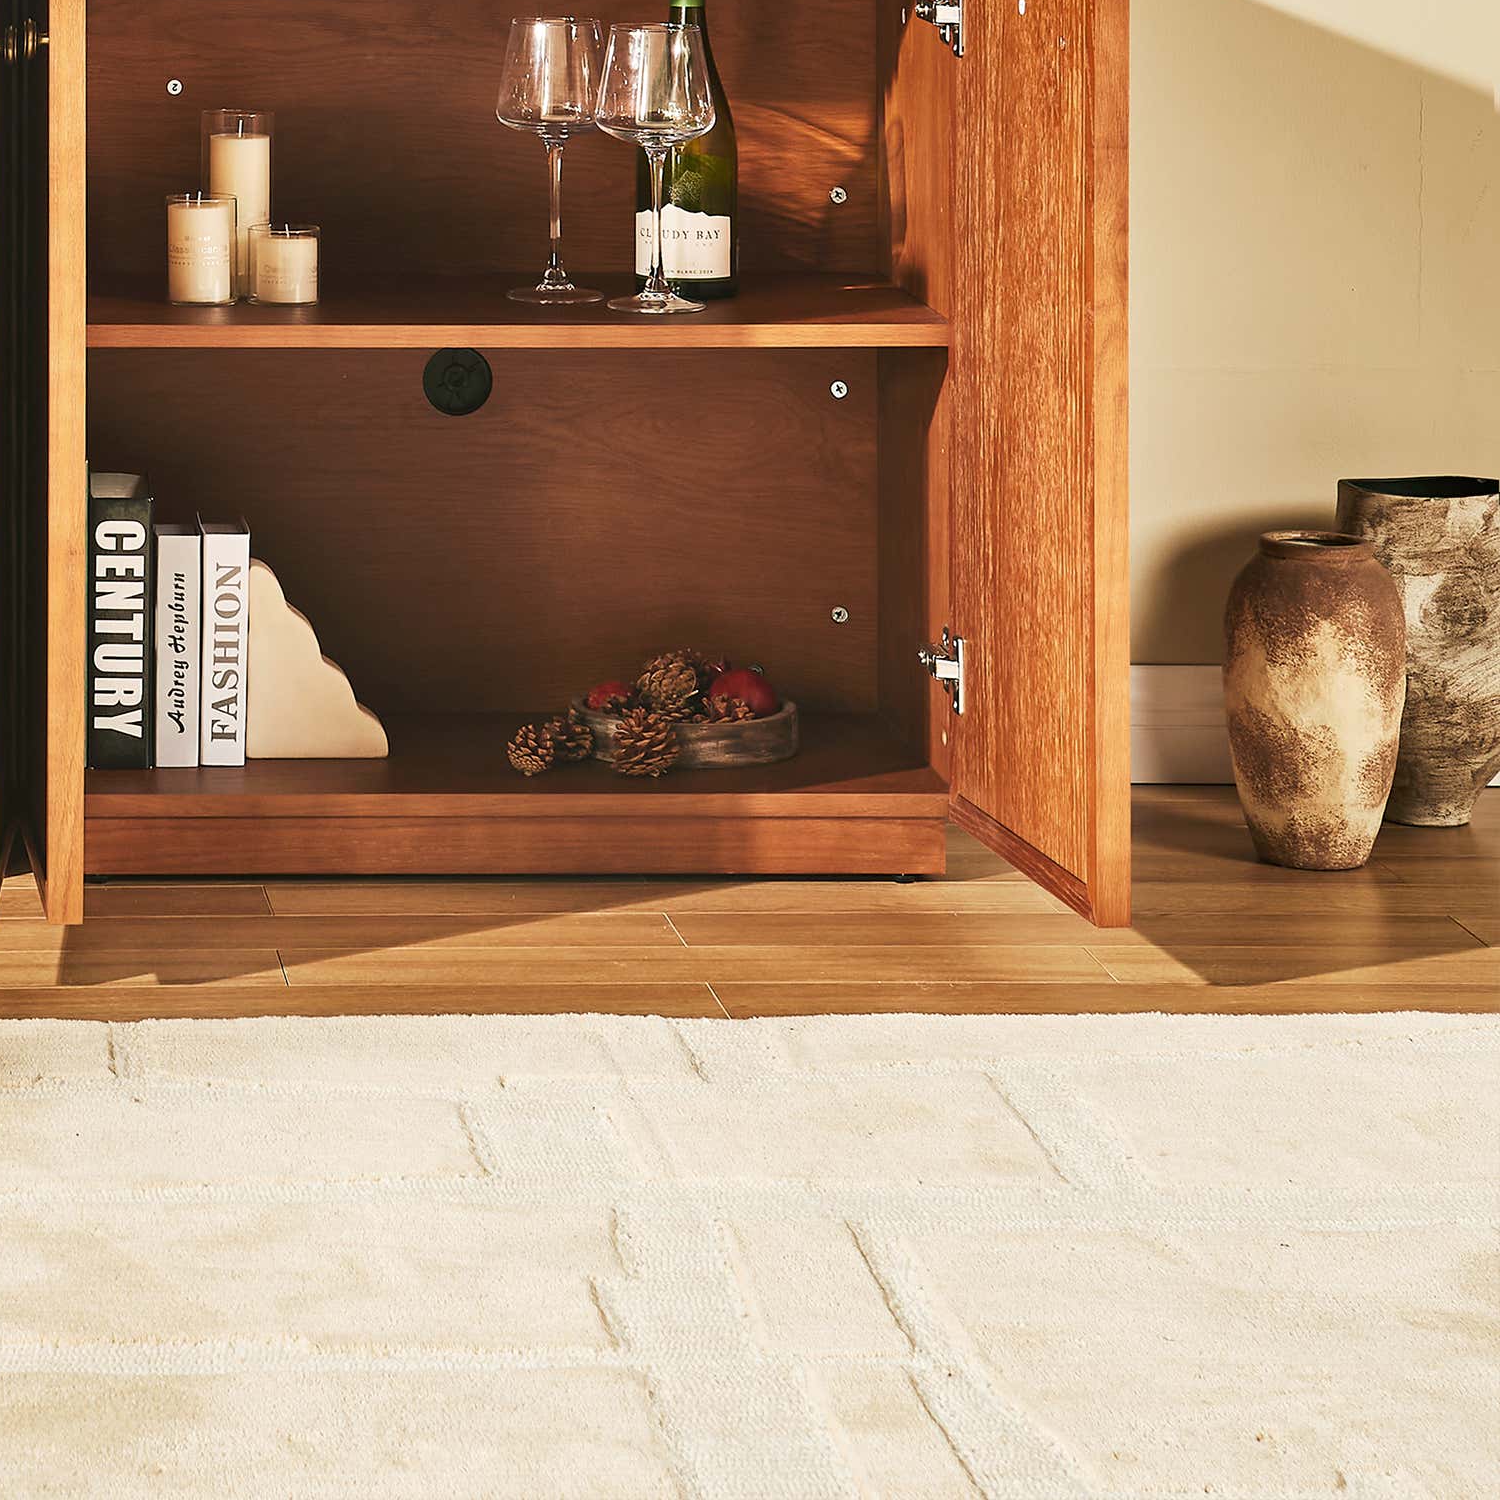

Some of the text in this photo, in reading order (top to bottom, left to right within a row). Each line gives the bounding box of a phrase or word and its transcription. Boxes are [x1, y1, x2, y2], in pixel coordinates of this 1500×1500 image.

[639, 227, 721, 240] CLUDY BAY
[93, 520, 146, 739] CENTURY
[167, 572, 190, 734] Audrey Hepburn
[210, 562, 242, 743] FASHION
